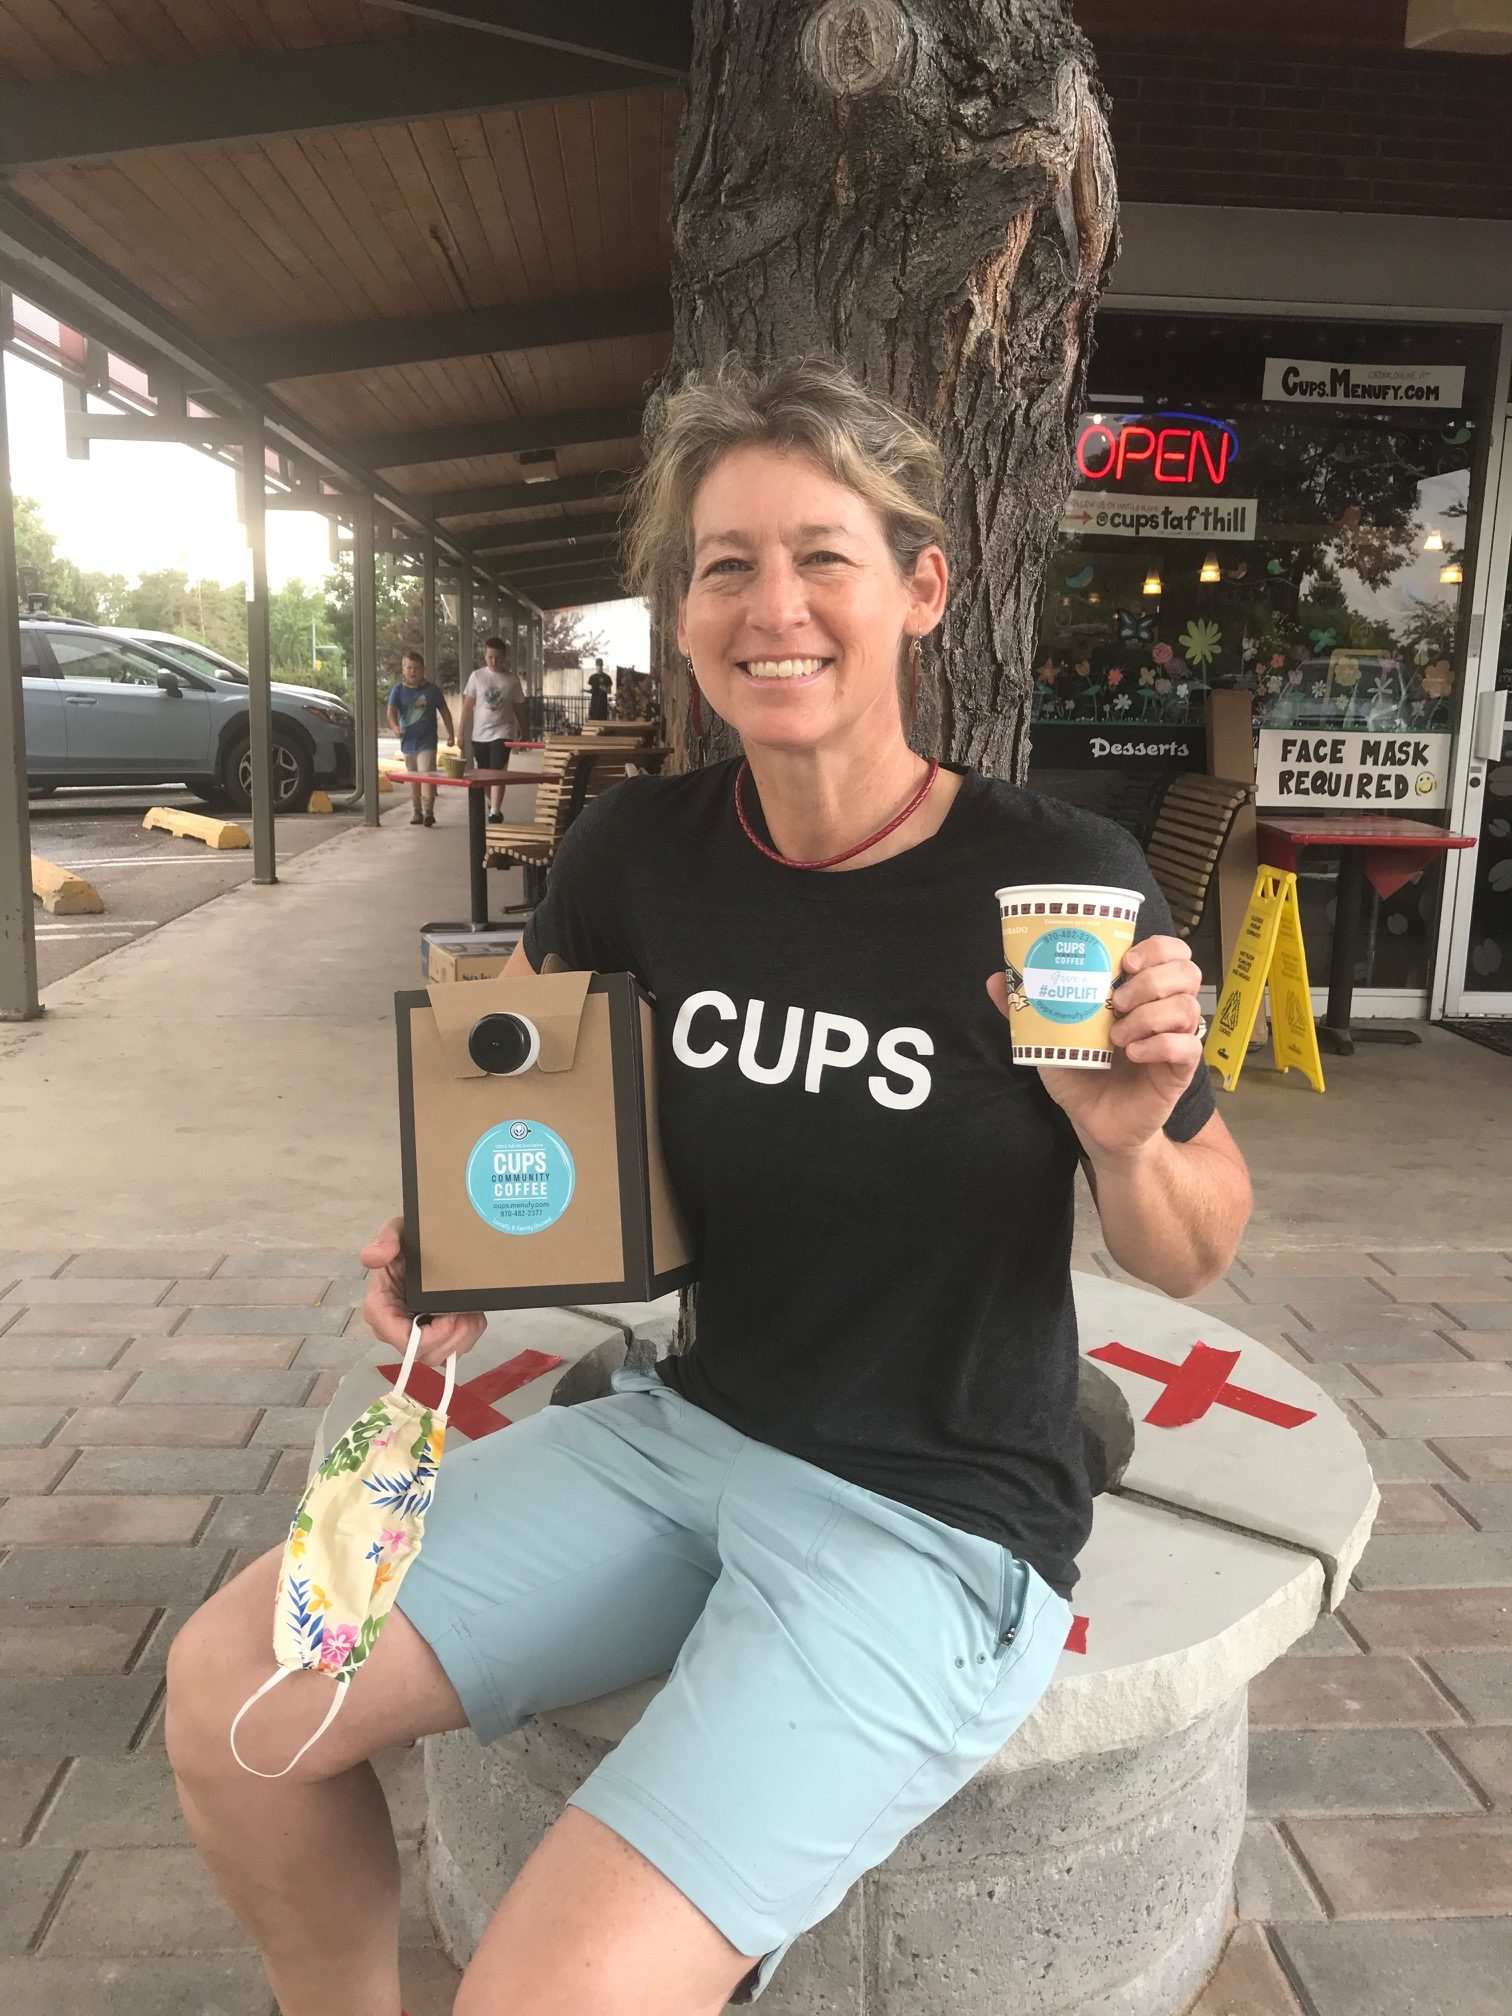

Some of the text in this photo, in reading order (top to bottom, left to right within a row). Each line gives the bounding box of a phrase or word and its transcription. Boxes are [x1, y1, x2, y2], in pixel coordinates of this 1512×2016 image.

[1077, 425, 1229, 485] OPEN
[1096, 505, 1247, 536] @cupstafthill
[1089, 737, 1190, 758] Desserts
[1281, 738, 1430, 767] FACE MASK
[1279, 770, 1409, 800] REQUIRED
[1055, 941, 1086, 954] CUPS
[1054, 956, 1085, 965] COFFEE
[672, 990, 935, 1111] CUPS
[493, 1151, 547, 1174] CUPS
[491, 1173, 550, 1183] COMMUNITY
[494, 1182, 548, 1197] COFFEE
[493, 1201, 550, 1210] cups.menufy.com
